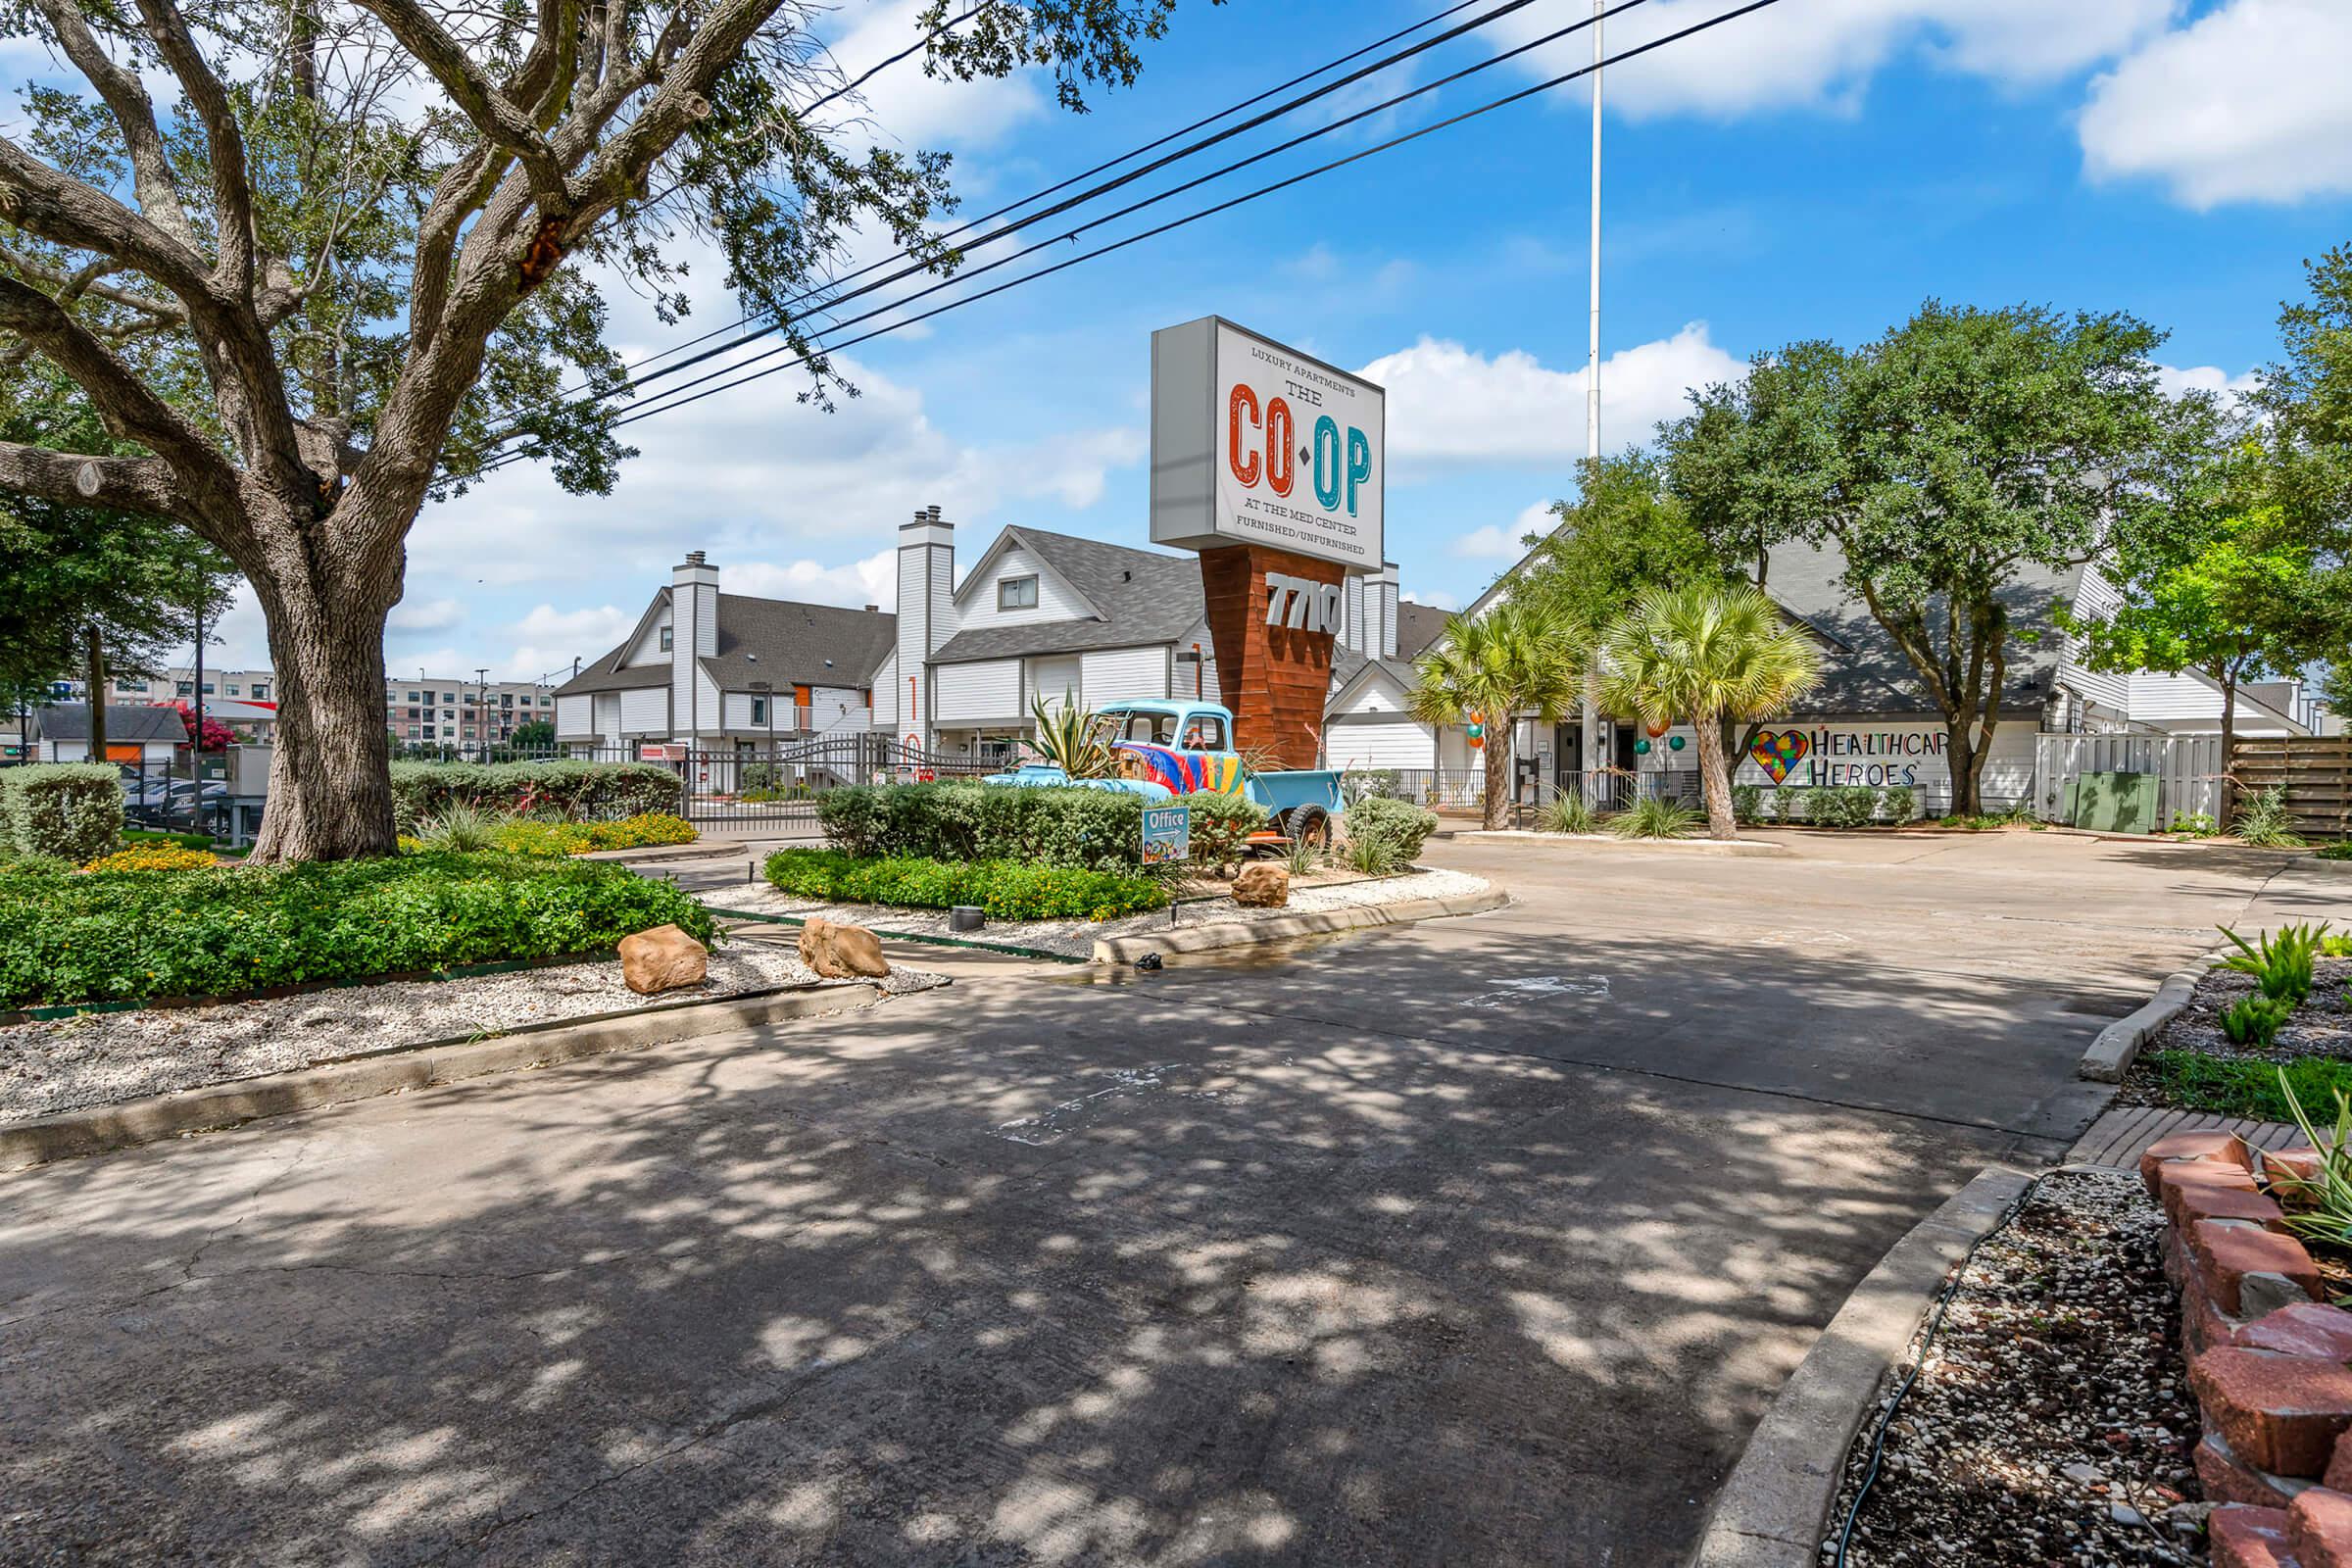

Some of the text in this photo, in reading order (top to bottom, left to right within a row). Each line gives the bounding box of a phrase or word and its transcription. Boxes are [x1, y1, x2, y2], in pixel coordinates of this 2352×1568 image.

[1251, 347, 1355, 398] LUXURY APARTMENTS
[1285, 379, 1322, 407] THE
[1245, 497, 1357, 536] AT THE MED CENTER
[1265, 572, 1343, 635] 7710
[1810, 759, 1918, 787] HEROES
[1149, 811, 1184, 829] Office
